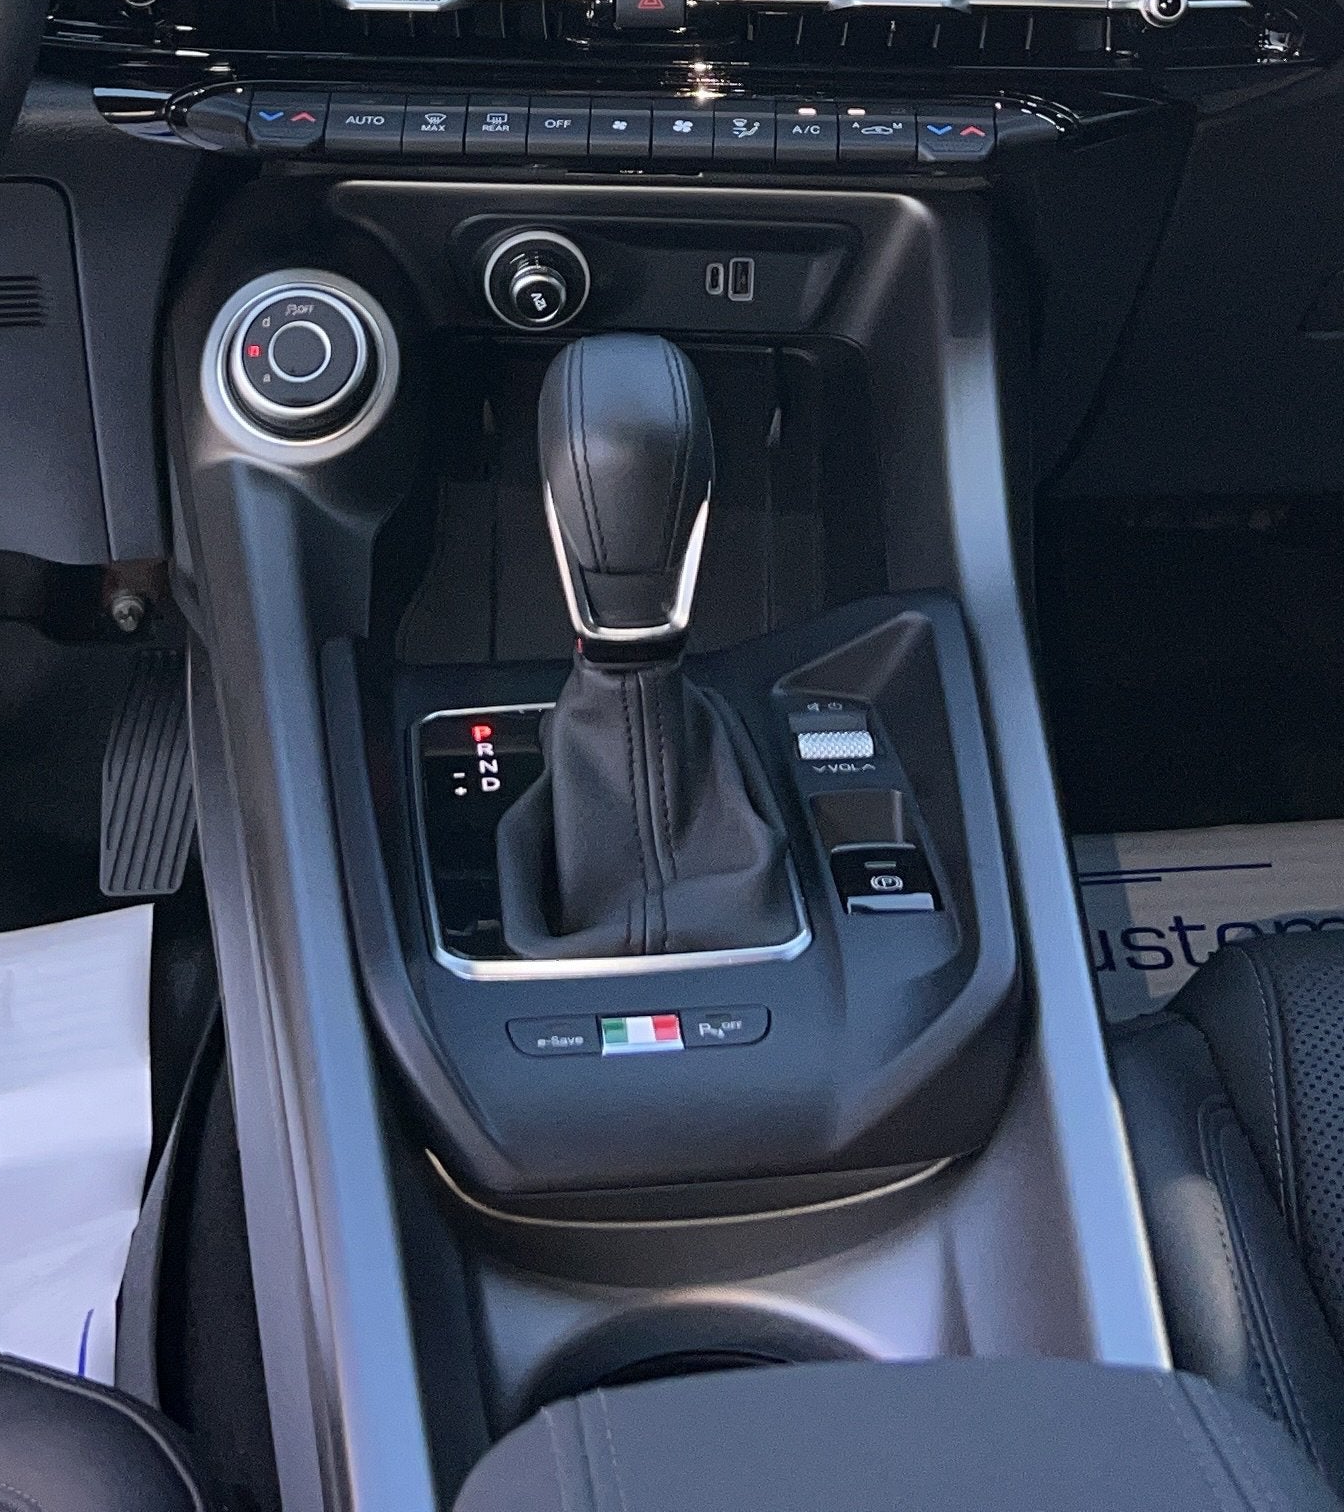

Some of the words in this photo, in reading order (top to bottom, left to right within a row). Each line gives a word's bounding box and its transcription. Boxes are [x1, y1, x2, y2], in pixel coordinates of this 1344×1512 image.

[345, 115, 385, 126] AUTO
[544, 119, 572, 129] OFF
[420, 124, 446, 132] MAX
[481, 124, 510, 132] REAR
[792, 125, 821, 135] A/C
[471, 725, 492, 742] P
[477, 742, 495, 757] R
[479, 758, 499, 774] N
[481, 776, 501, 792] D
